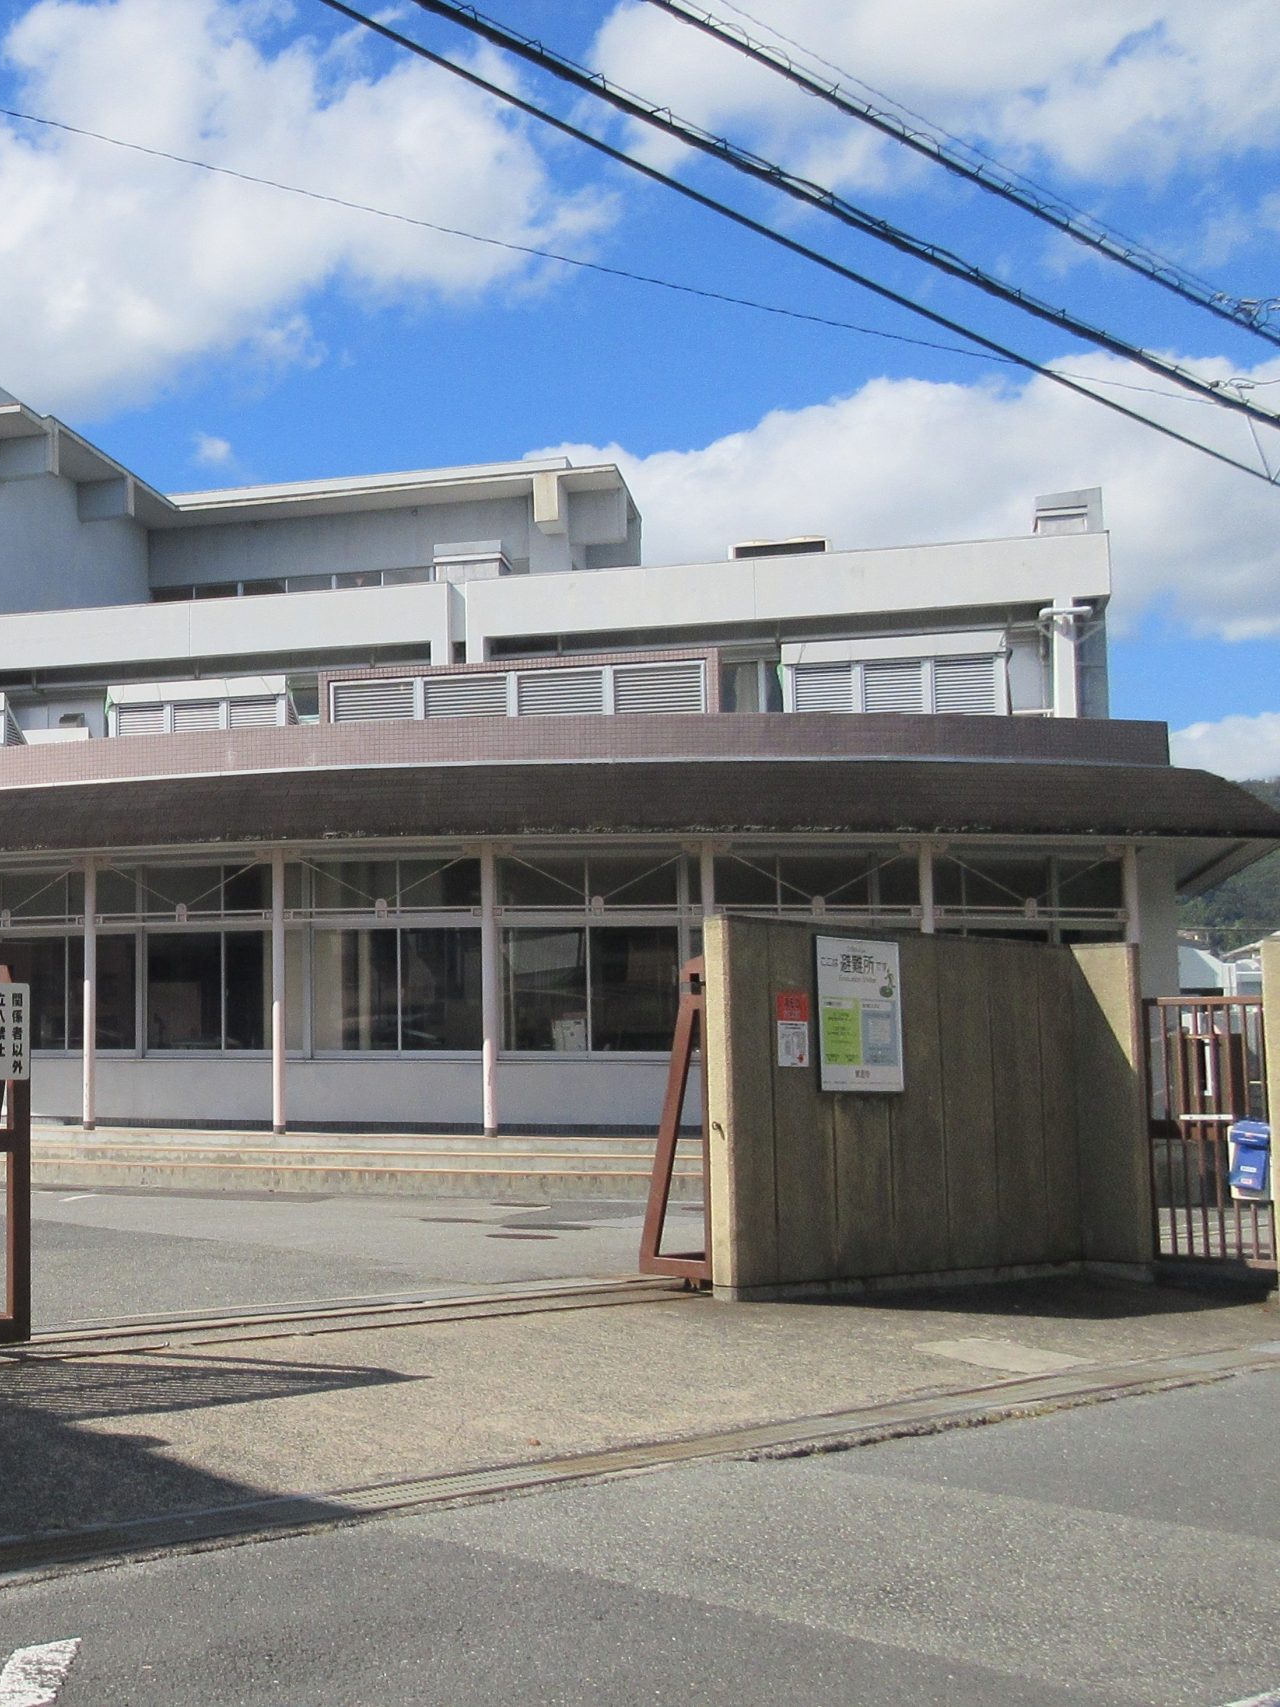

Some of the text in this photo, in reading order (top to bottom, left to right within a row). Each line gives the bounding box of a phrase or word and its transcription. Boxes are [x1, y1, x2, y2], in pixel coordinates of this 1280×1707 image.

[12, 992, 23, 1074] 関係者以外
